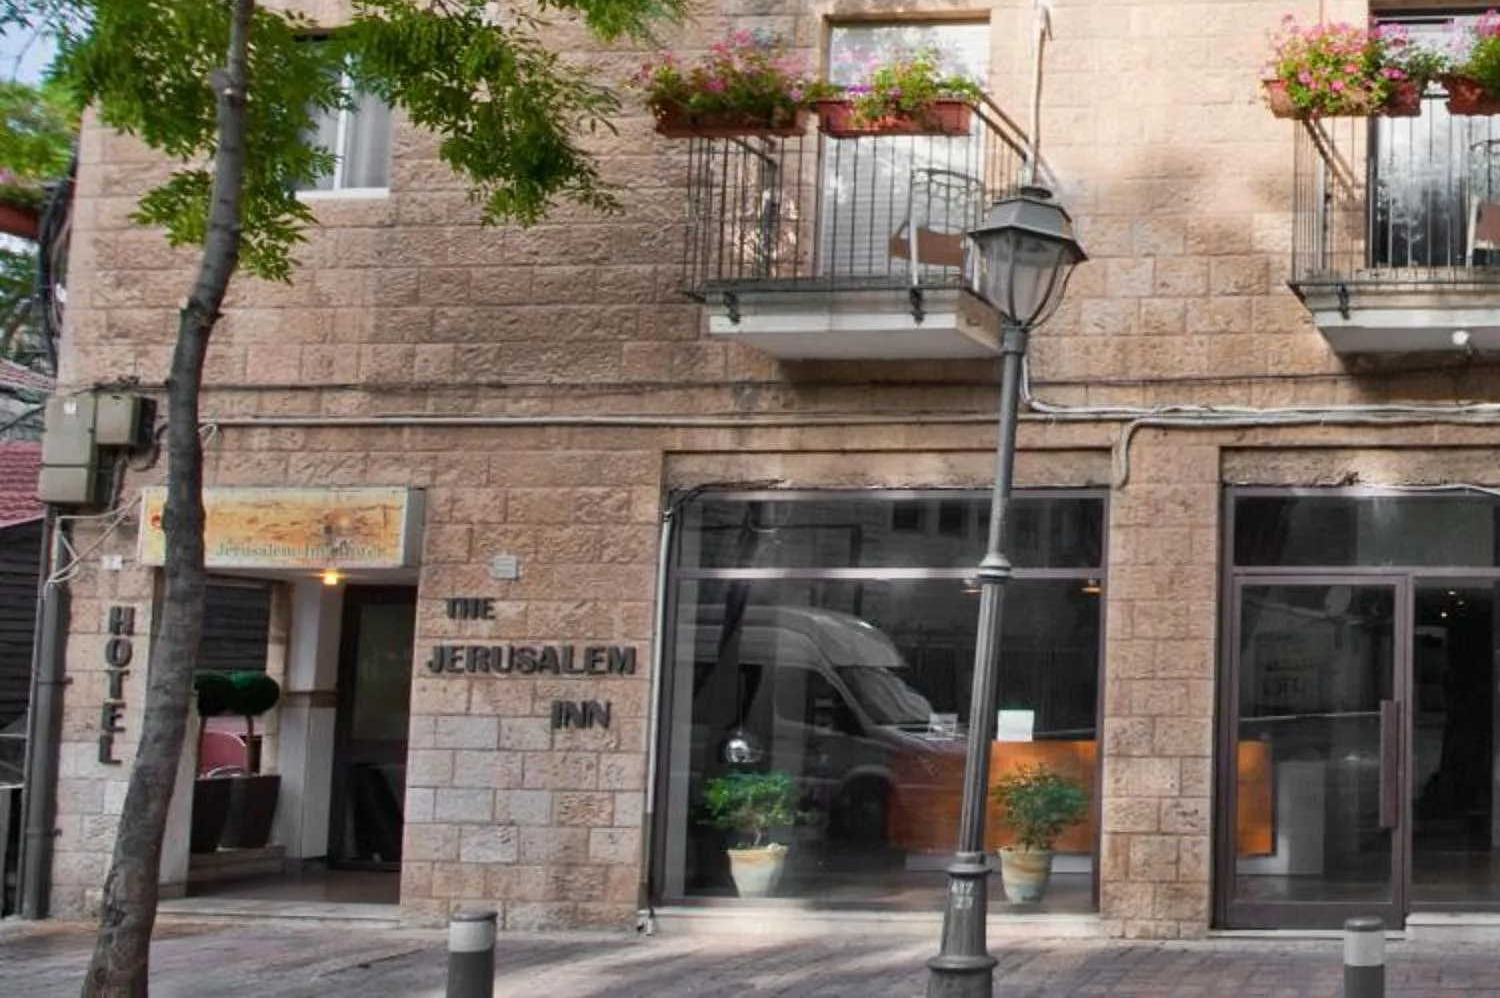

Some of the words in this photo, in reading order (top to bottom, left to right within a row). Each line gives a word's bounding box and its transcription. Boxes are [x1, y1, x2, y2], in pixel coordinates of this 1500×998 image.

[443, 597, 496, 620] THE
[426, 645, 636, 675] JERUSALEM
[99, 606, 136, 765] HOTEL
[551, 700, 611, 729] INN
